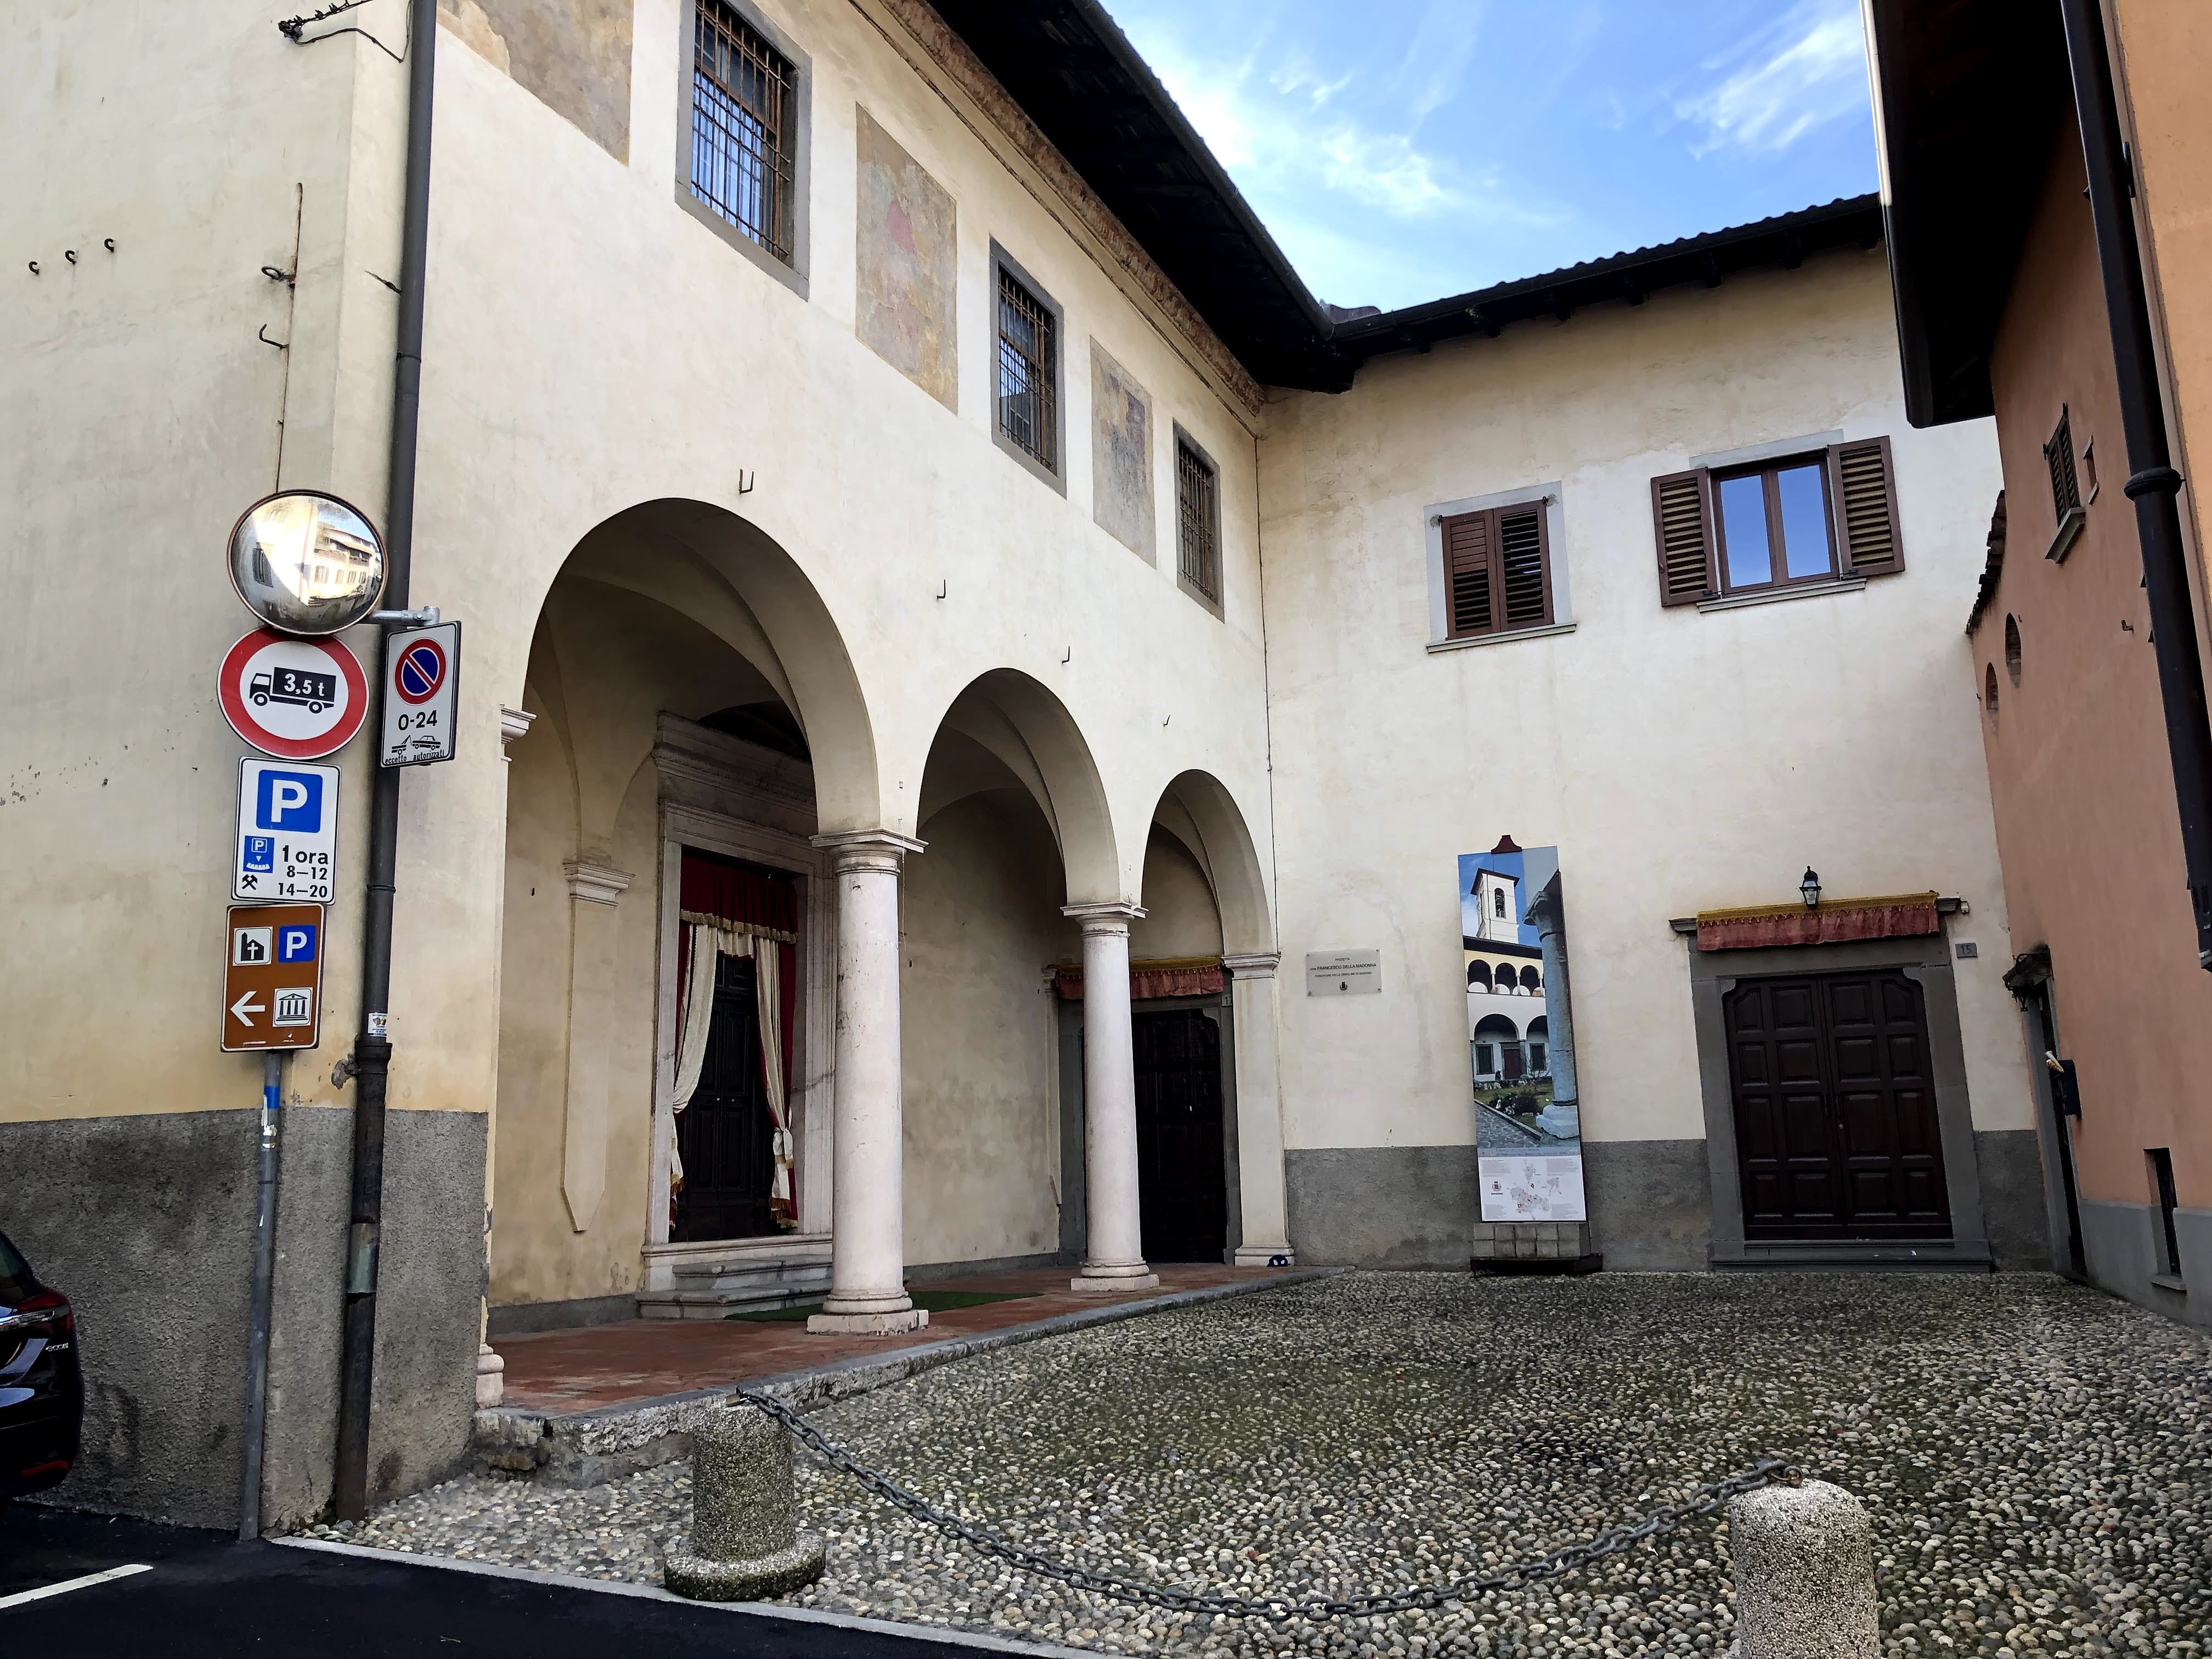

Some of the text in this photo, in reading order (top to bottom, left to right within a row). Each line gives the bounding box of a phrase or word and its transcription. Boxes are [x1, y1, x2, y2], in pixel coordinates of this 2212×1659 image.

[284, 673, 325, 697] 3,5 t
[398, 710, 438, 731] 0-24
[385, 749, 445, 764] eccetto autorizzati
[271, 779, 308, 823] P
[255, 840, 264, 851] P
[282, 845, 329, 865] 1 ora
[286, 865, 328, 880] 8-12
[279, 882, 328, 898] 14-20
[286, 931, 307, 958] P
[1960, 945, 1972, 955] 15
